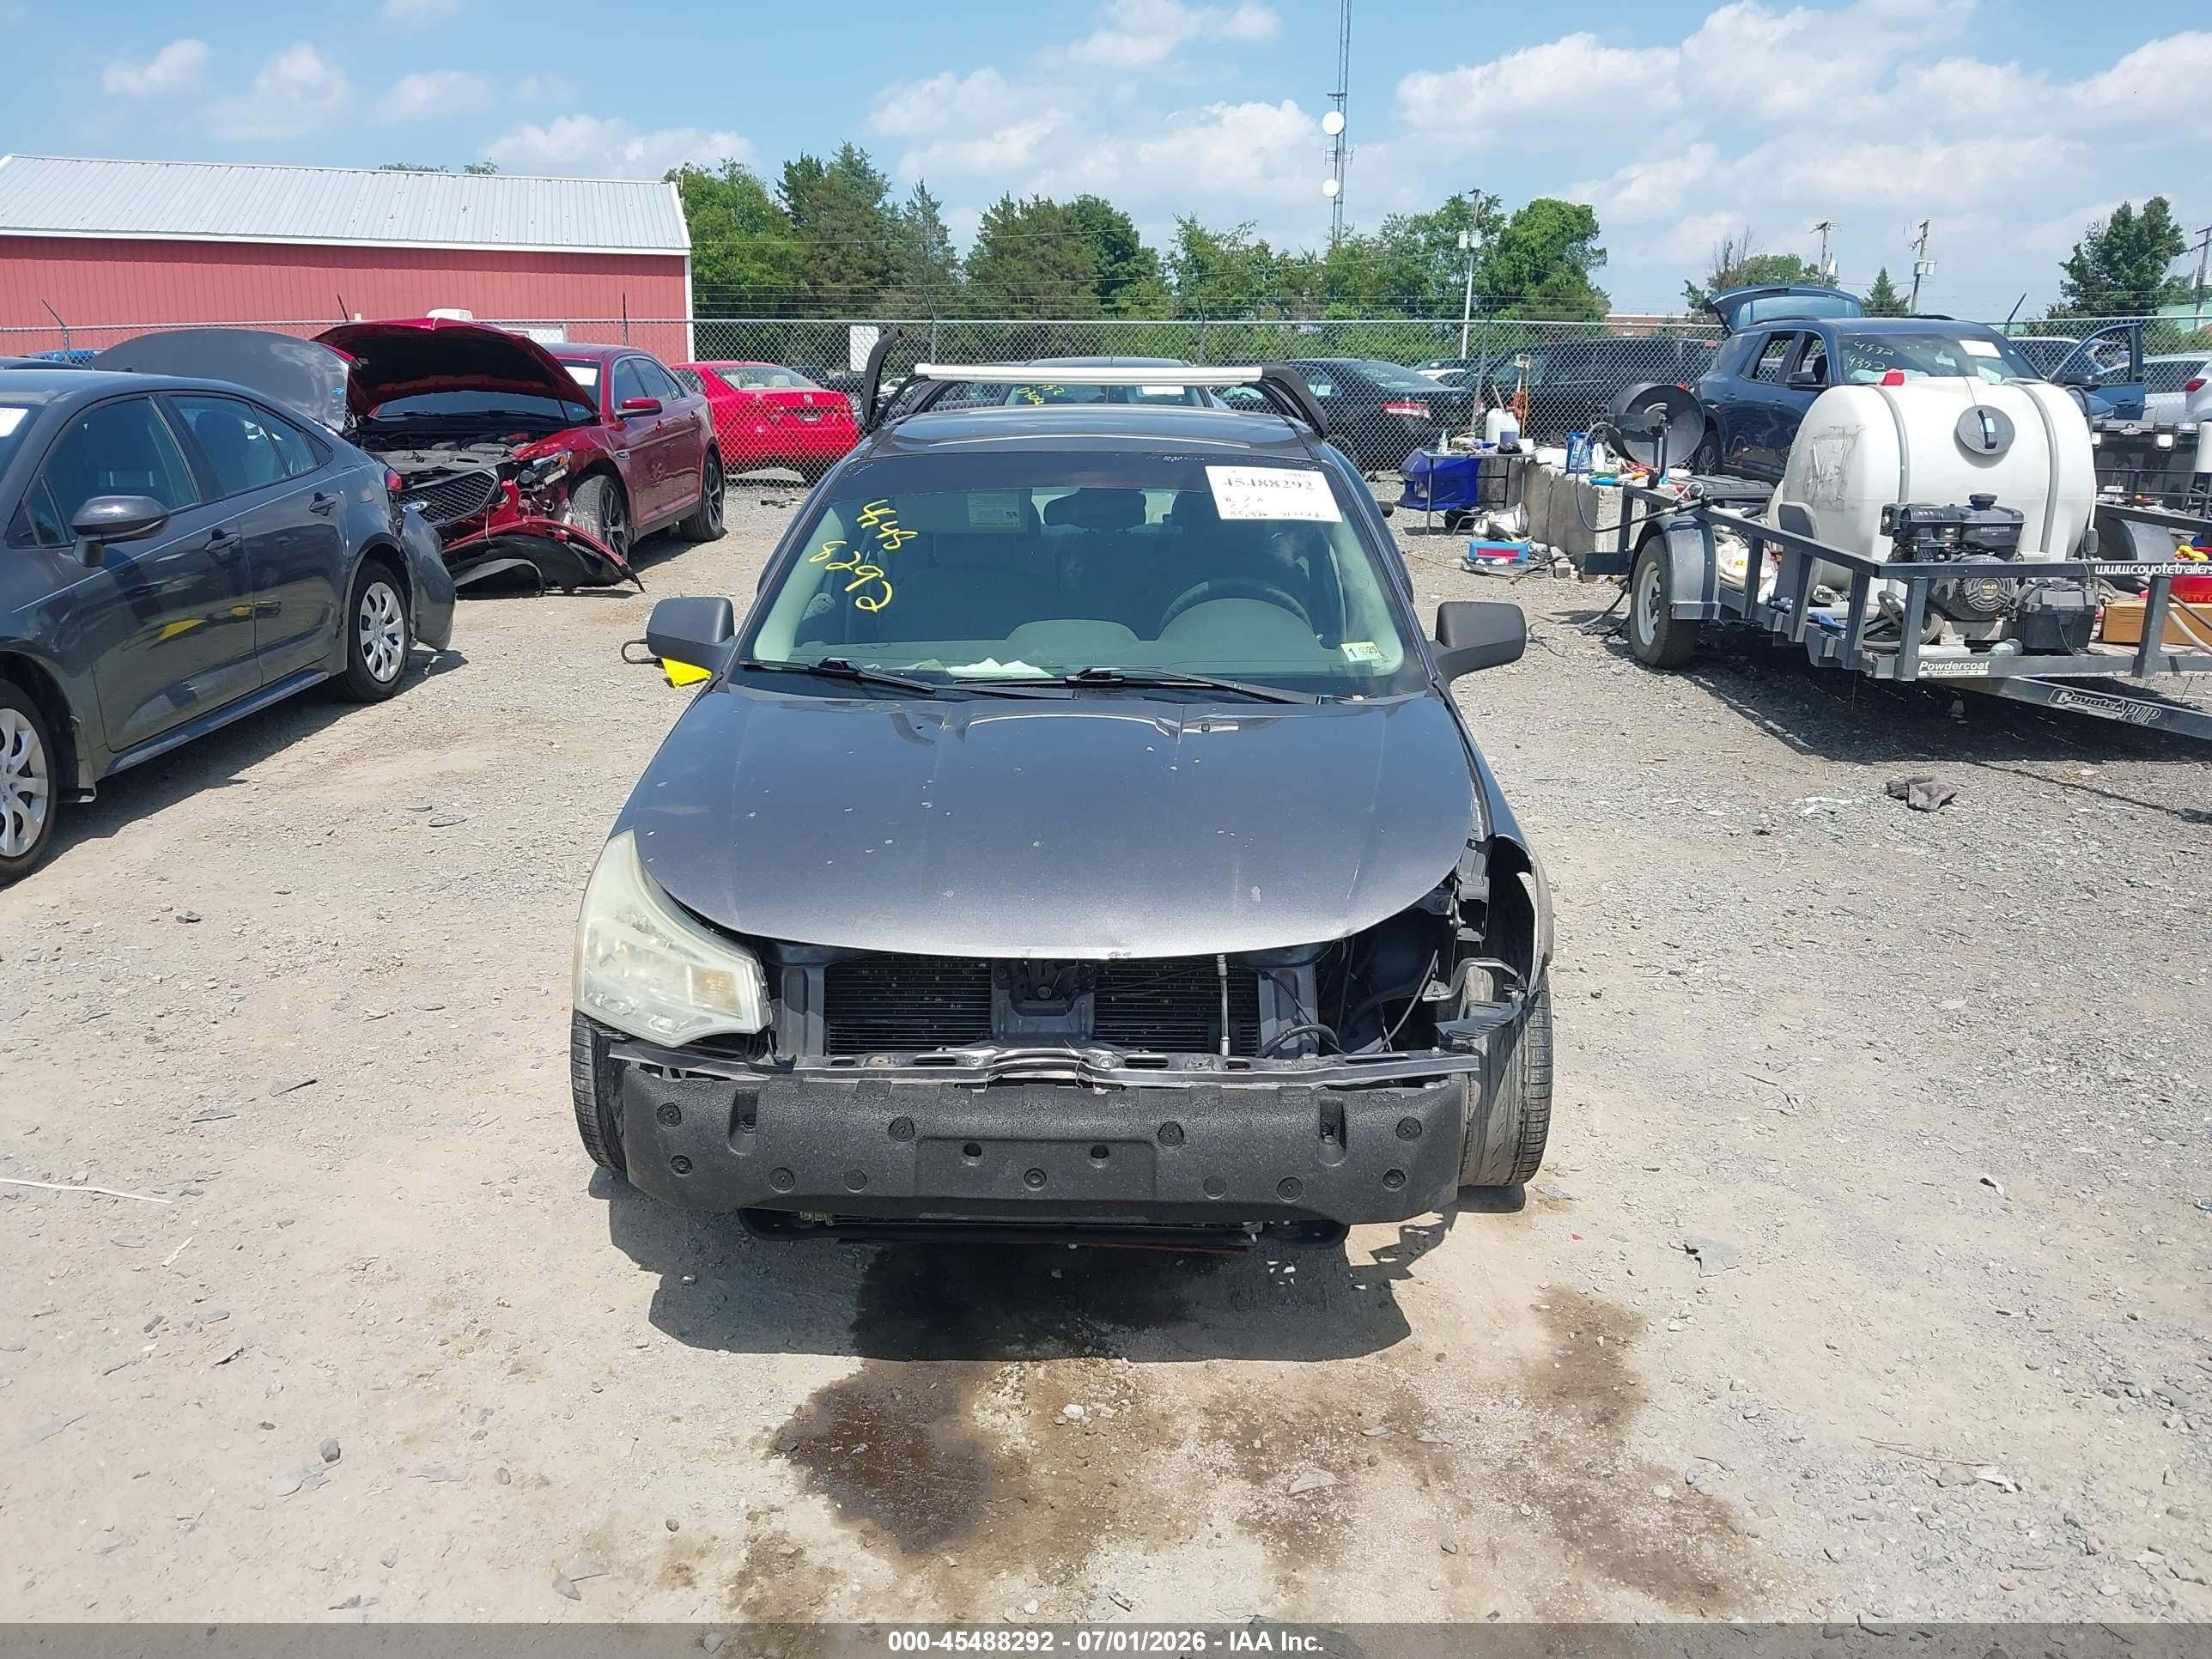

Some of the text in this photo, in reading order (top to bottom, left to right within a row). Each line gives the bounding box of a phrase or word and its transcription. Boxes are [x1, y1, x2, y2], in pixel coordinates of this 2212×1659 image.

[808, 540, 894, 613] 8292
[1918, 660, 1990, 671] Powdercoat
[2047, 688, 2118, 712] Coyote
[2120, 702, 2162, 725] PUP
